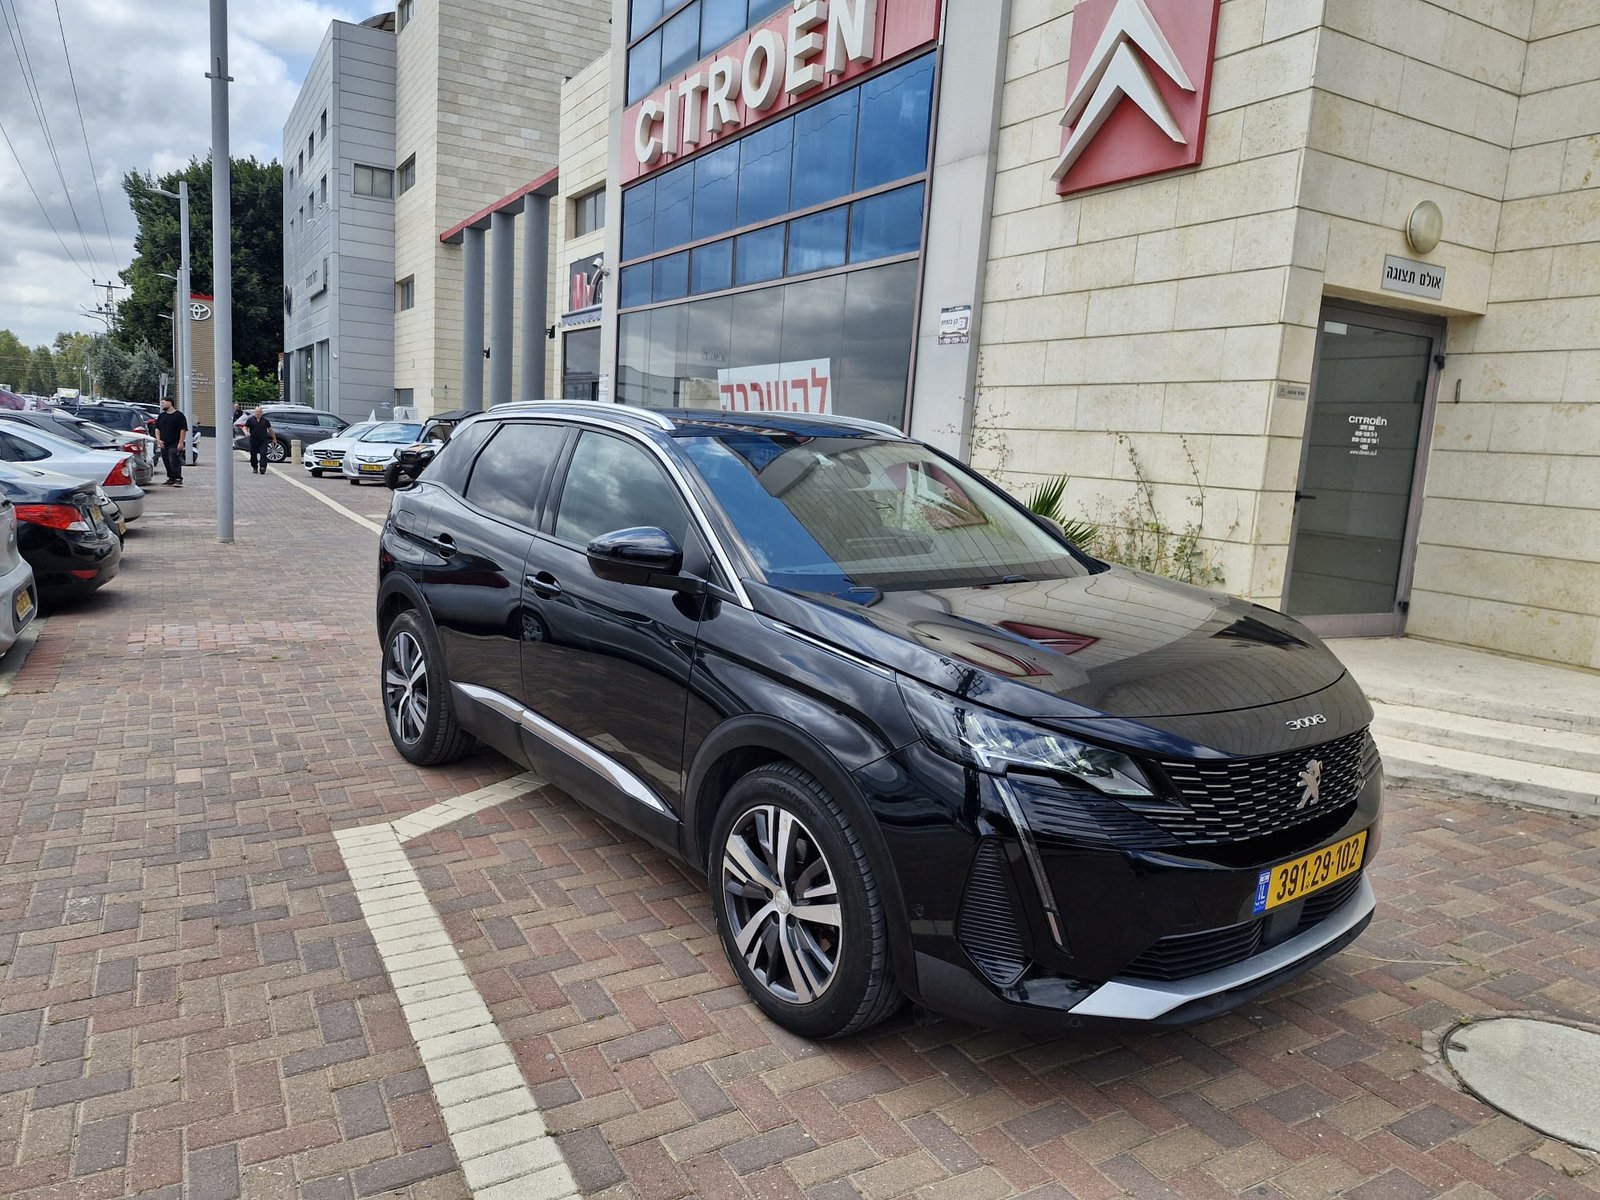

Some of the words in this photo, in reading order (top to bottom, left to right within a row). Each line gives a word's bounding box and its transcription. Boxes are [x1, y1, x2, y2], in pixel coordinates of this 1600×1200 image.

[635, 0, 876, 164] CITROËN
[1386, 266, 1416, 284] תצוגה
[1420, 271, 1442, 289] אולם
[720, 366, 828, 415] להשכרה
[1286, 713, 1326, 731] 3008
